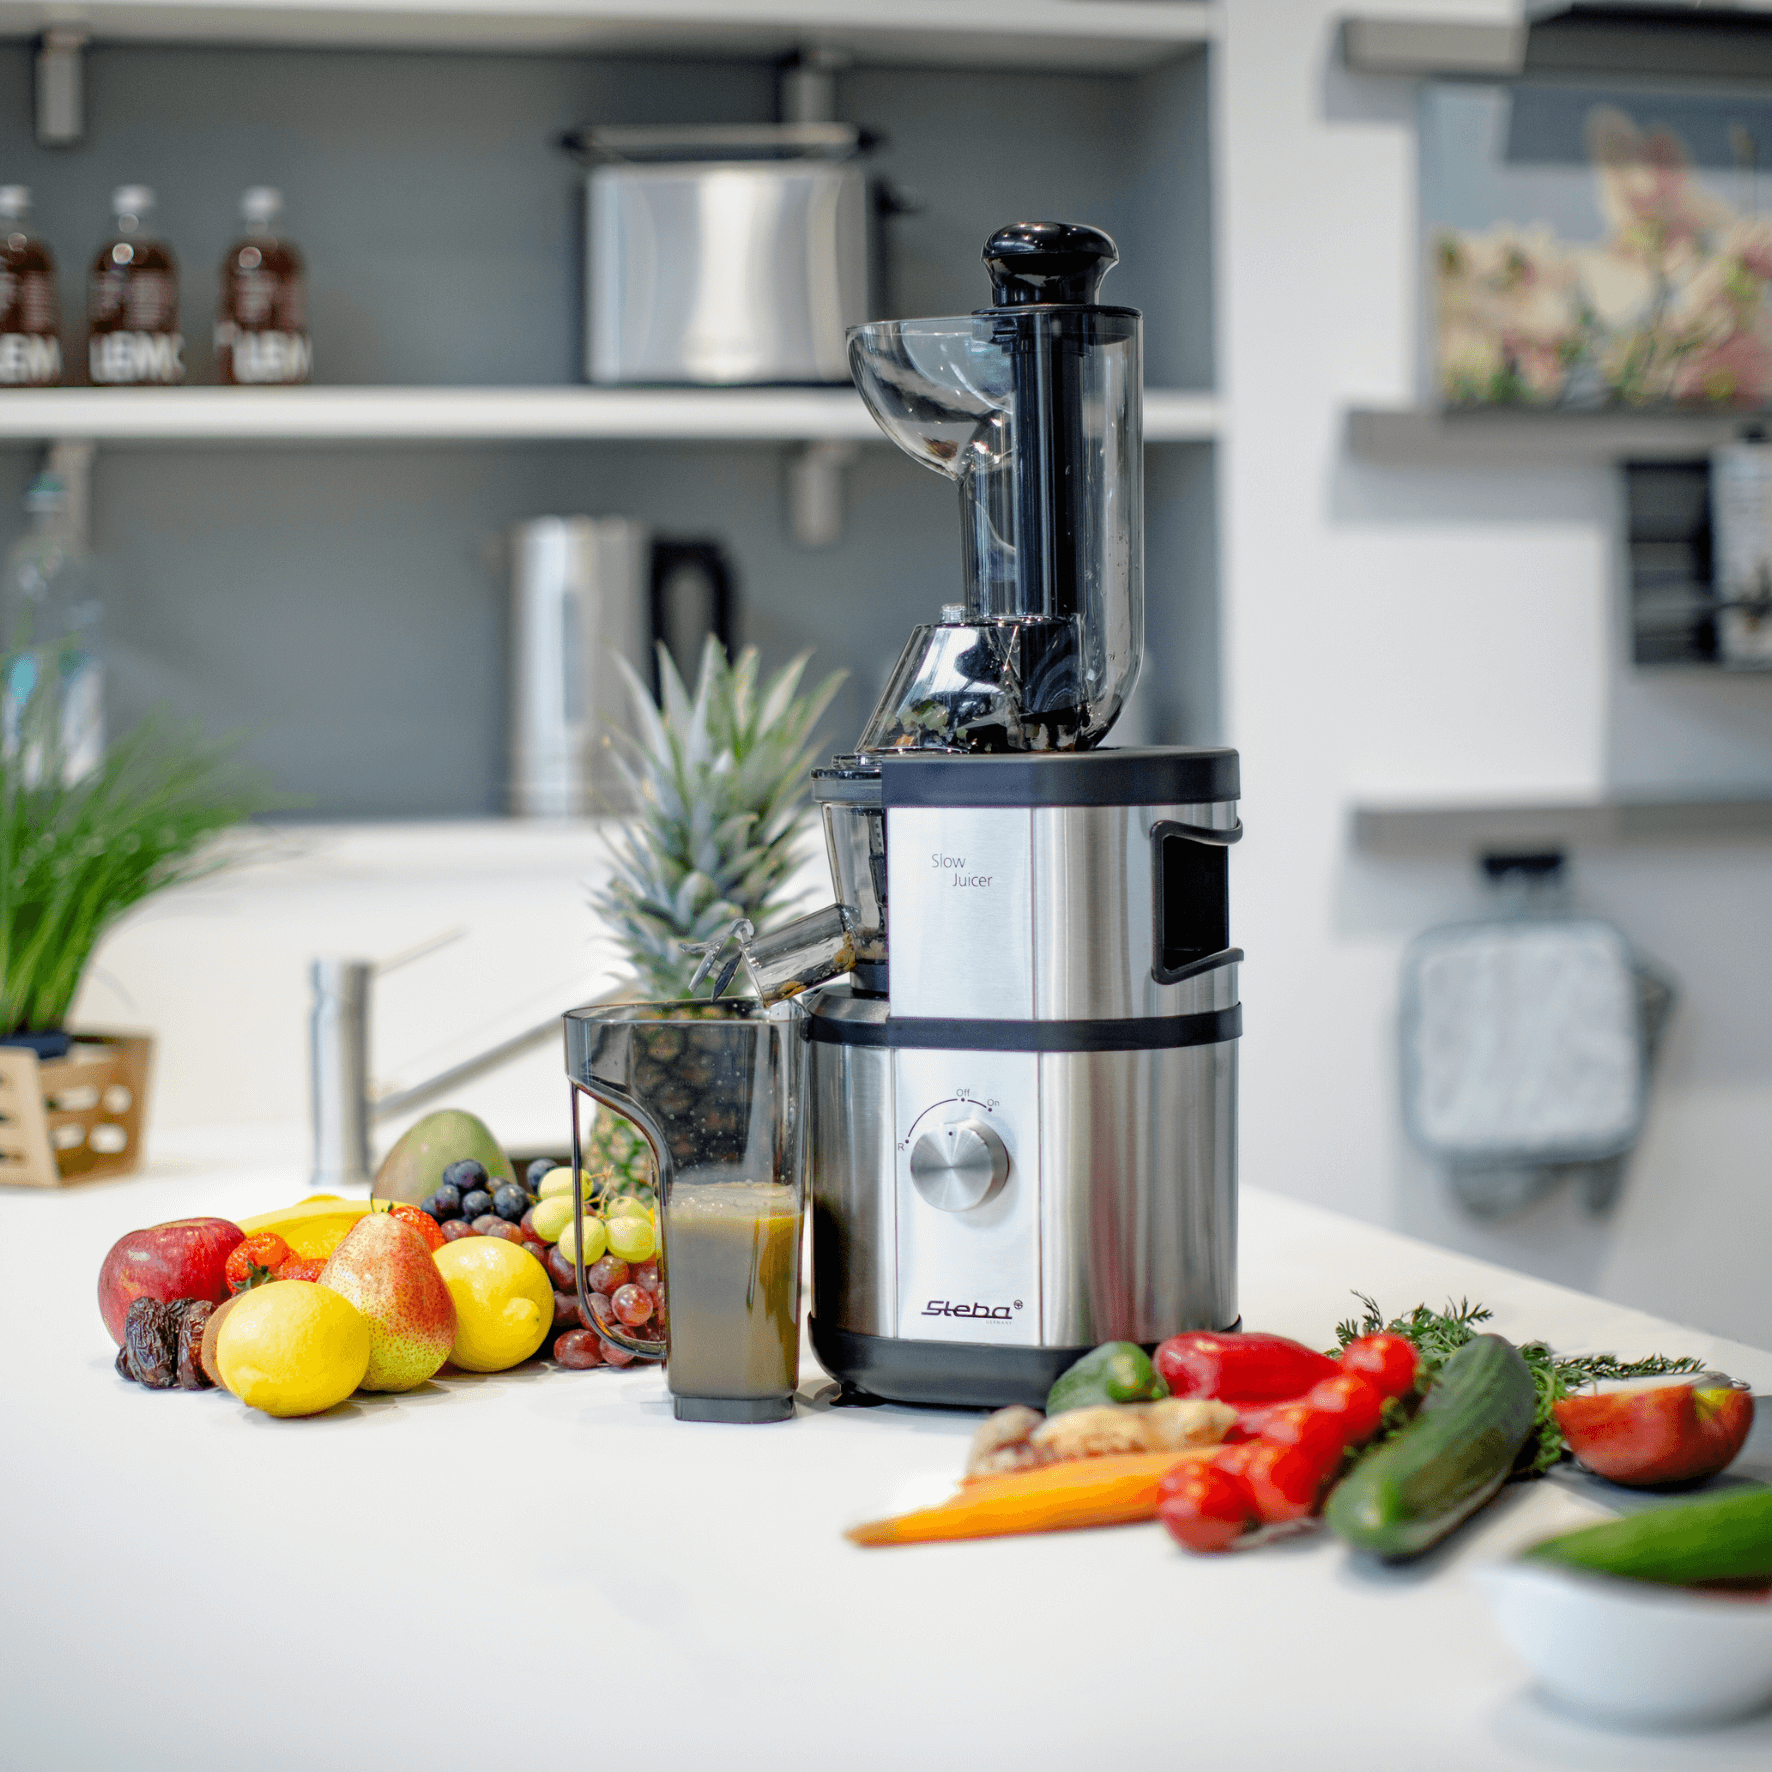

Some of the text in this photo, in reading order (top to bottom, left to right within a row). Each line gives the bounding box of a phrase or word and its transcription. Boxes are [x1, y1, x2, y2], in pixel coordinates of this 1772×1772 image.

[931, 853, 966, 868] Slow
[952, 872, 993, 887] Juicer
[956, 1088, 970, 1097] Off
[986, 1098, 1000, 1107] On
[897, 1142, 905, 1151] R
[921, 1300, 1013, 1319] Steba
